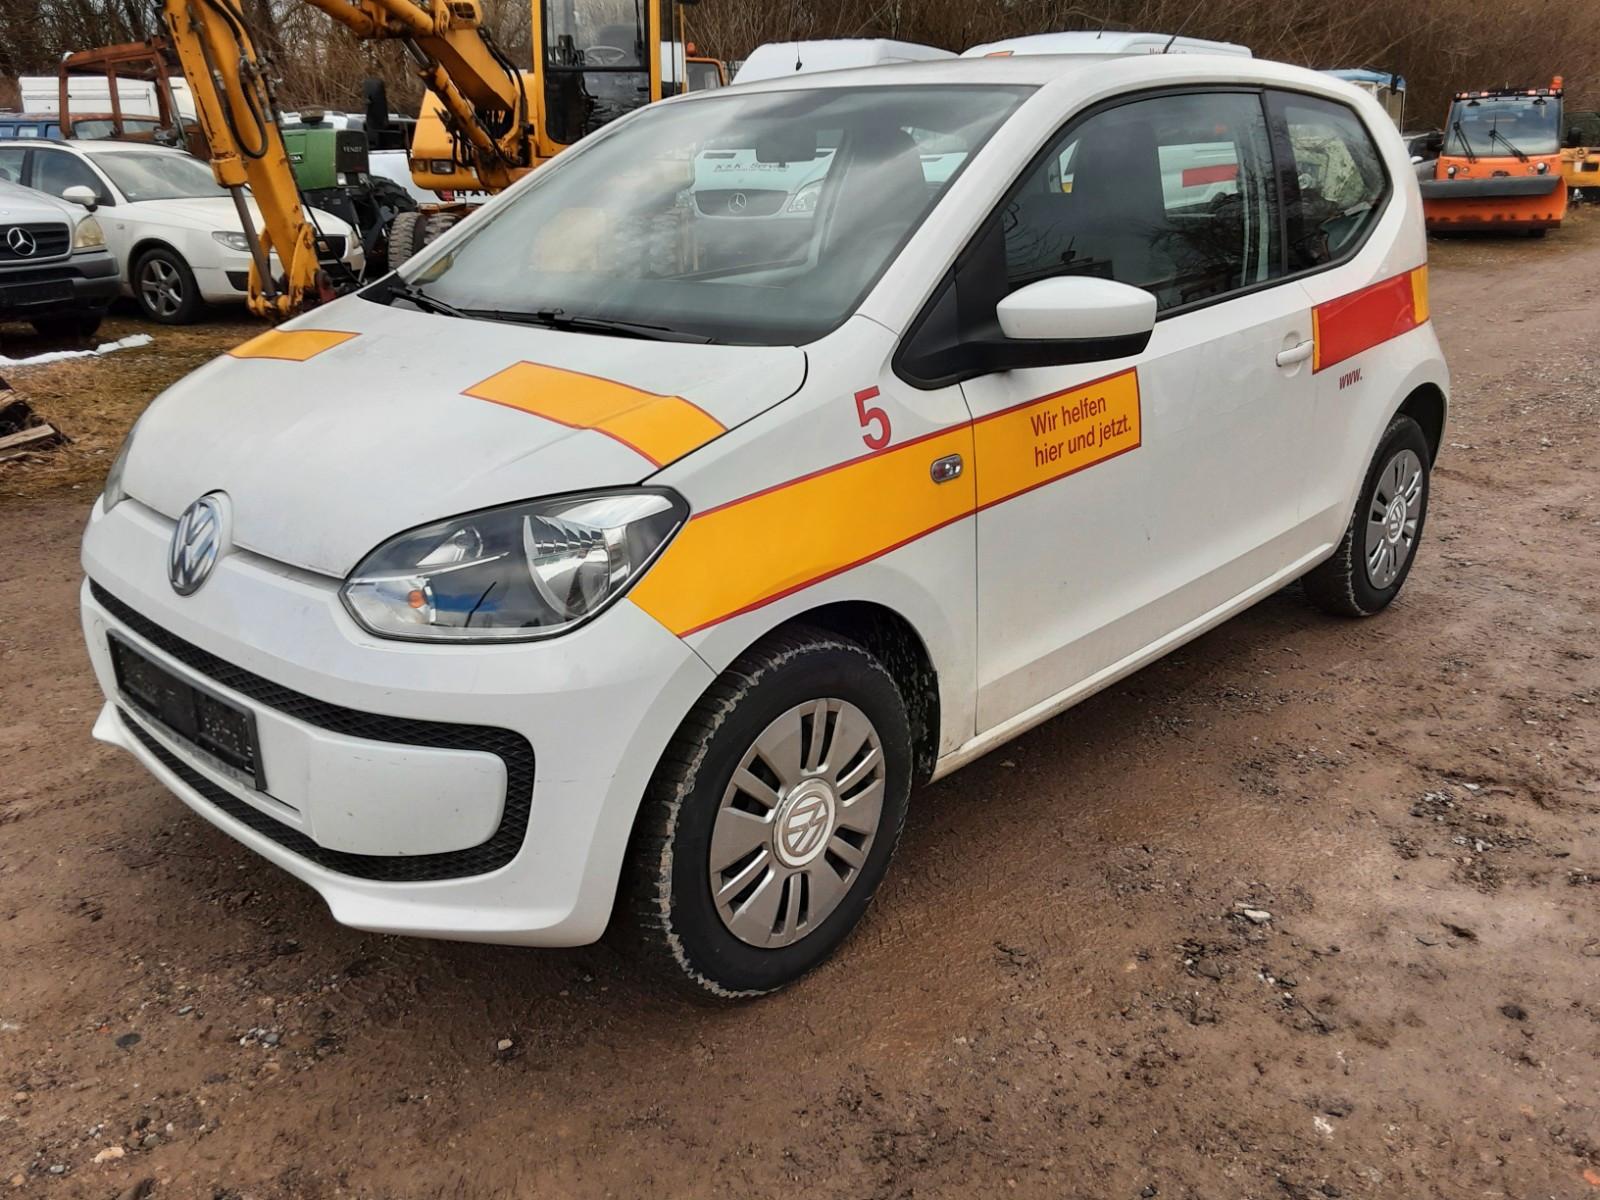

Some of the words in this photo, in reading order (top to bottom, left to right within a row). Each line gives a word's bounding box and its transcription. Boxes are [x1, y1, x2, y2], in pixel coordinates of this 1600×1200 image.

[1339, 367, 1363, 390] www.
[854, 385, 892, 450] 5
[1030, 410, 1058, 437] Wir
[1061, 397, 1106, 427] helfen
[1034, 442, 1064, 467] hier
[1068, 425, 1095, 454] und
[1098, 414, 1132, 448] jetzt.
